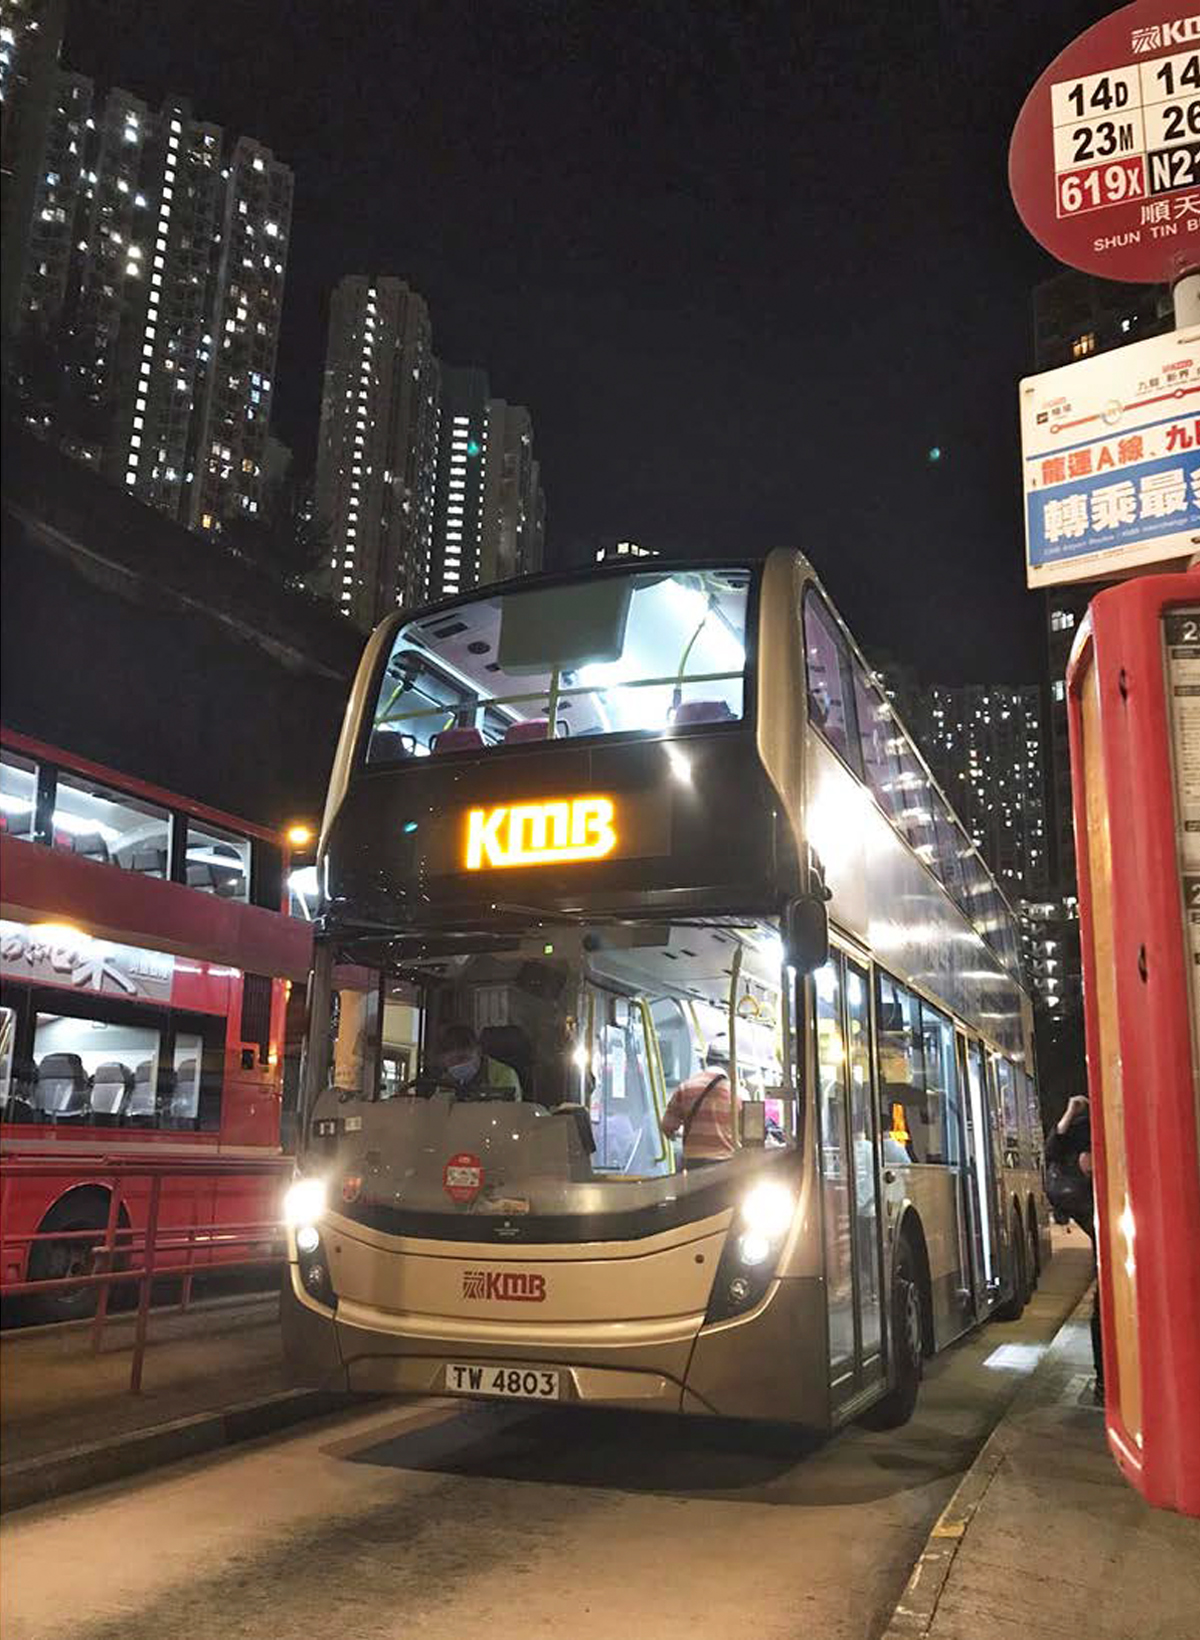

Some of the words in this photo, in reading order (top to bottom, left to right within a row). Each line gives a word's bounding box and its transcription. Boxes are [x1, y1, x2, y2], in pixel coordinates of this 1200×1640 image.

[1157, 55, 1200, 96] 14
[1068, 77, 1129, 117] 14D
[1162, 101, 1200, 141] 26
[1072, 121, 1134, 163] 23M
[1061, 165, 1141, 212] 619X
[1152, 149, 1200, 191] N2
[1141, 194, 1200, 226] 順天
[1093, 230, 1141, 252] SHUN
[1150, 222, 1178, 240] TIN
[1188, 217, 1200, 232] B
[465, 795, 618, 871] KMB
[486, 1272, 547, 1302] KMB
[453, 1366, 483, 1390] TW
[492, 1369, 556, 1396] 4803
